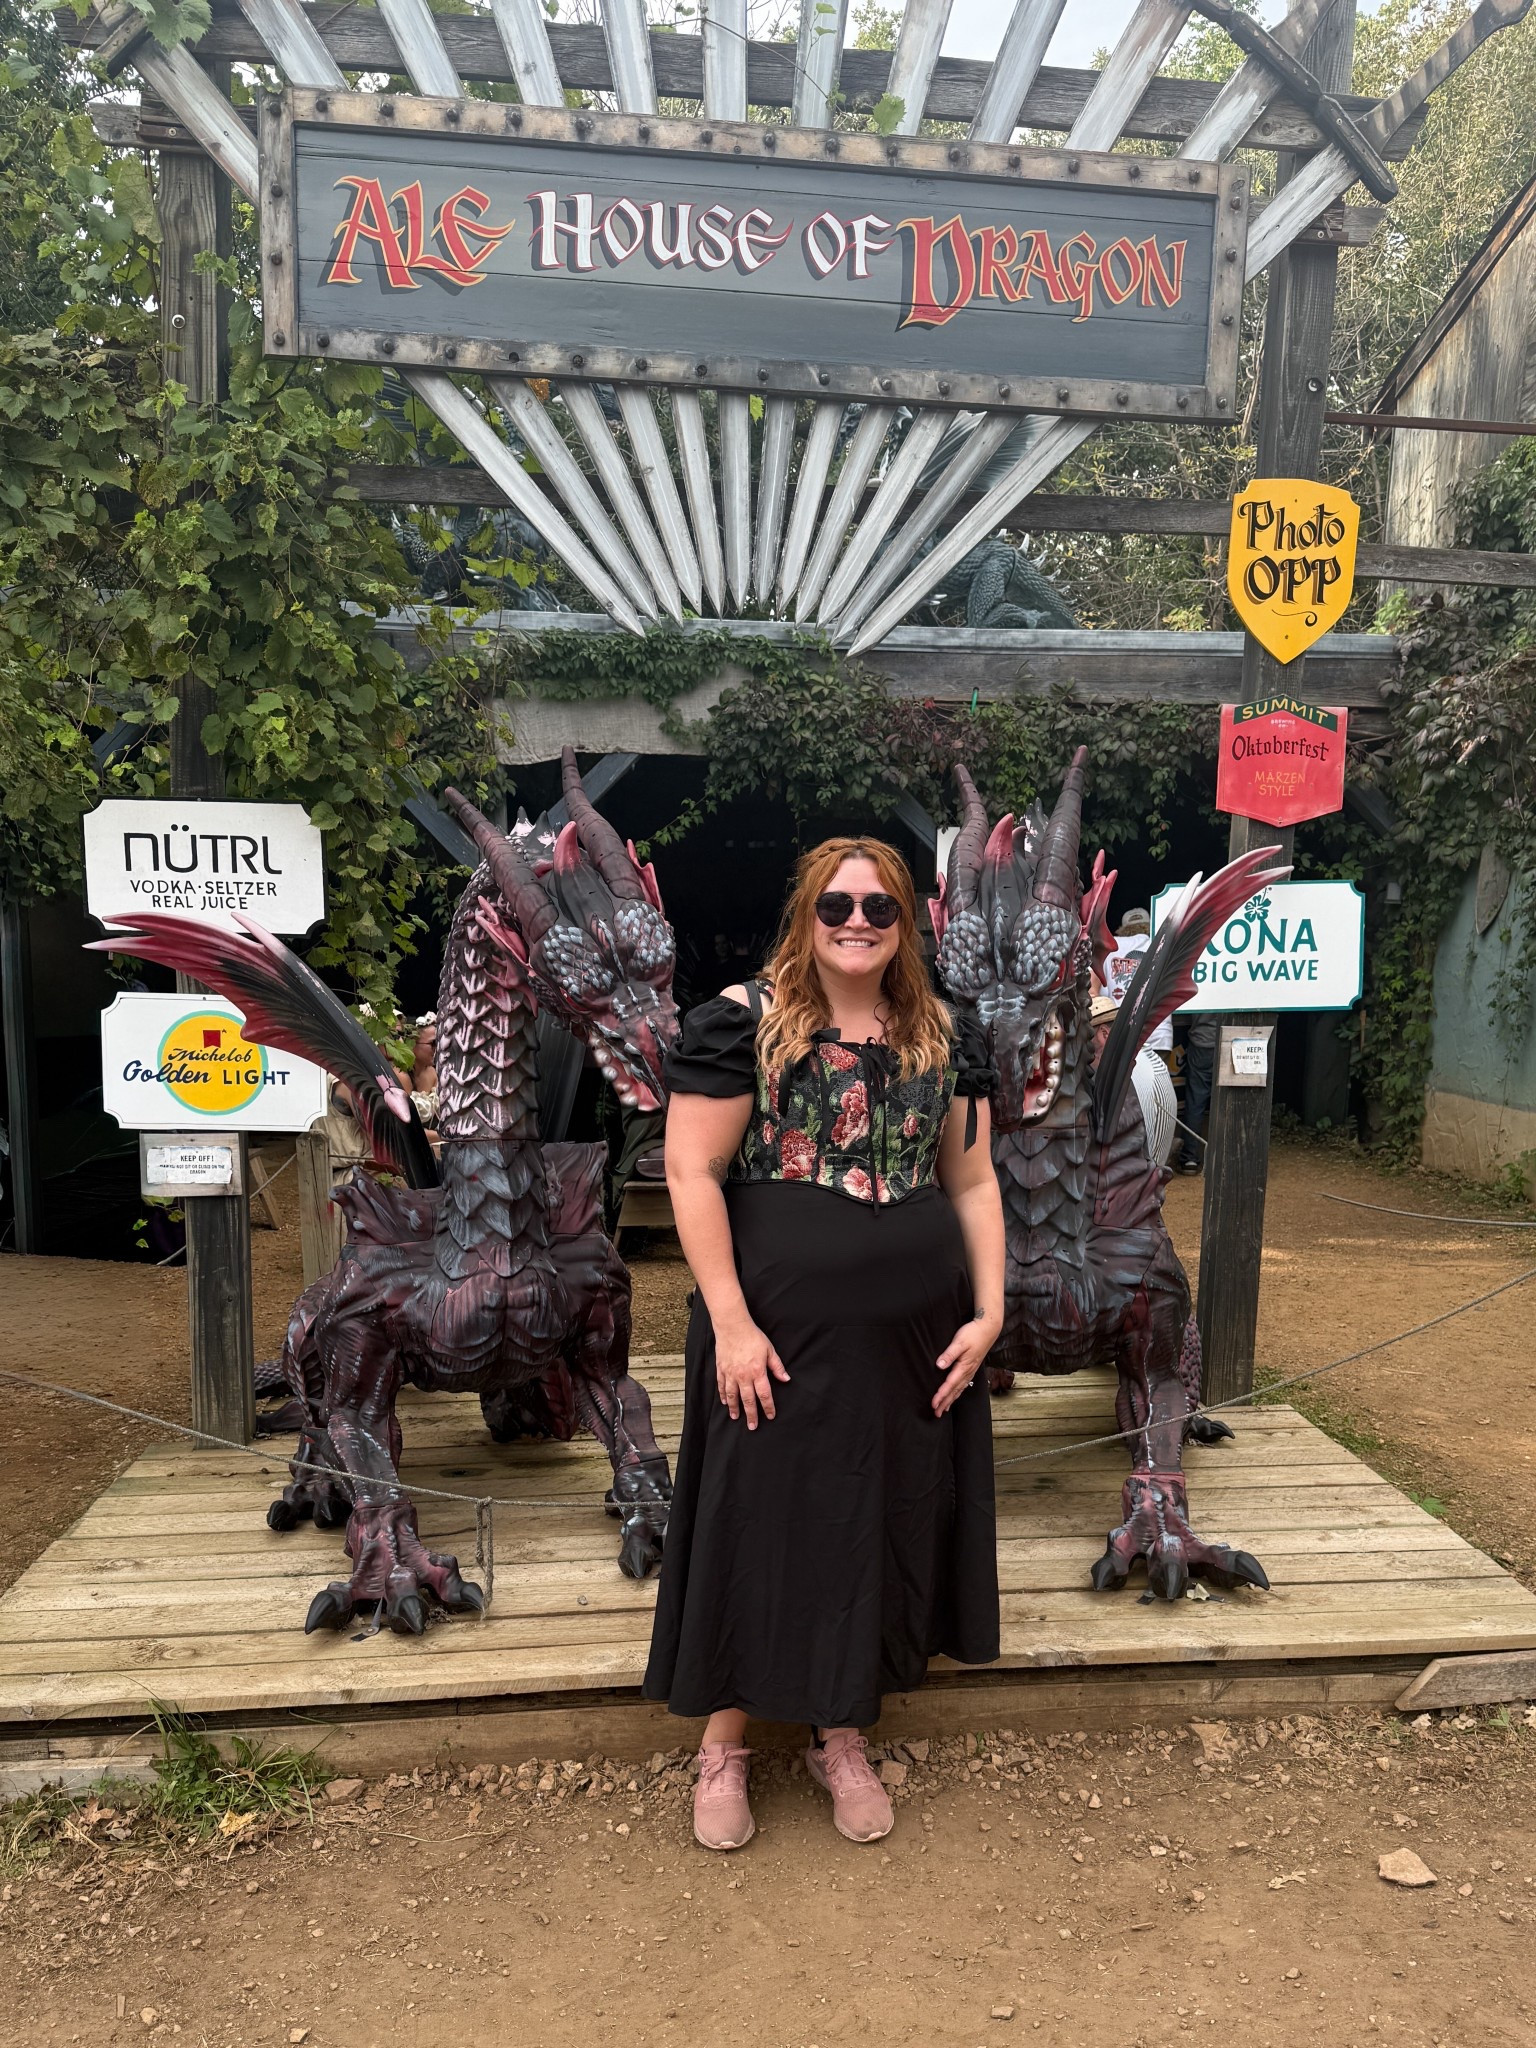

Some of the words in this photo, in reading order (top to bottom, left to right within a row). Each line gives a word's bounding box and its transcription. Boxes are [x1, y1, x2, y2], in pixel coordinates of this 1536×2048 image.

[804, 209, 896, 280] OF
[1238, 499, 1345, 552] Photo
[1241, 697, 1329, 725] SUMMIT
[1231, 734, 1330, 763] Oktoberfest
[1258, 783, 1296, 798] STYLE
[151, 894, 194, 909] REAL
[200, 895, 249, 911] JUICE
[1206, 918, 1319, 957] ONA
[1193, 960, 1238, 983] BIG
[1246, 959, 1320, 982] WAVE
[167, 1047, 253, 1063] Michelob
[122, 1059, 212, 1084] Golden
[222, 1069, 291, 1086] LIGHT
